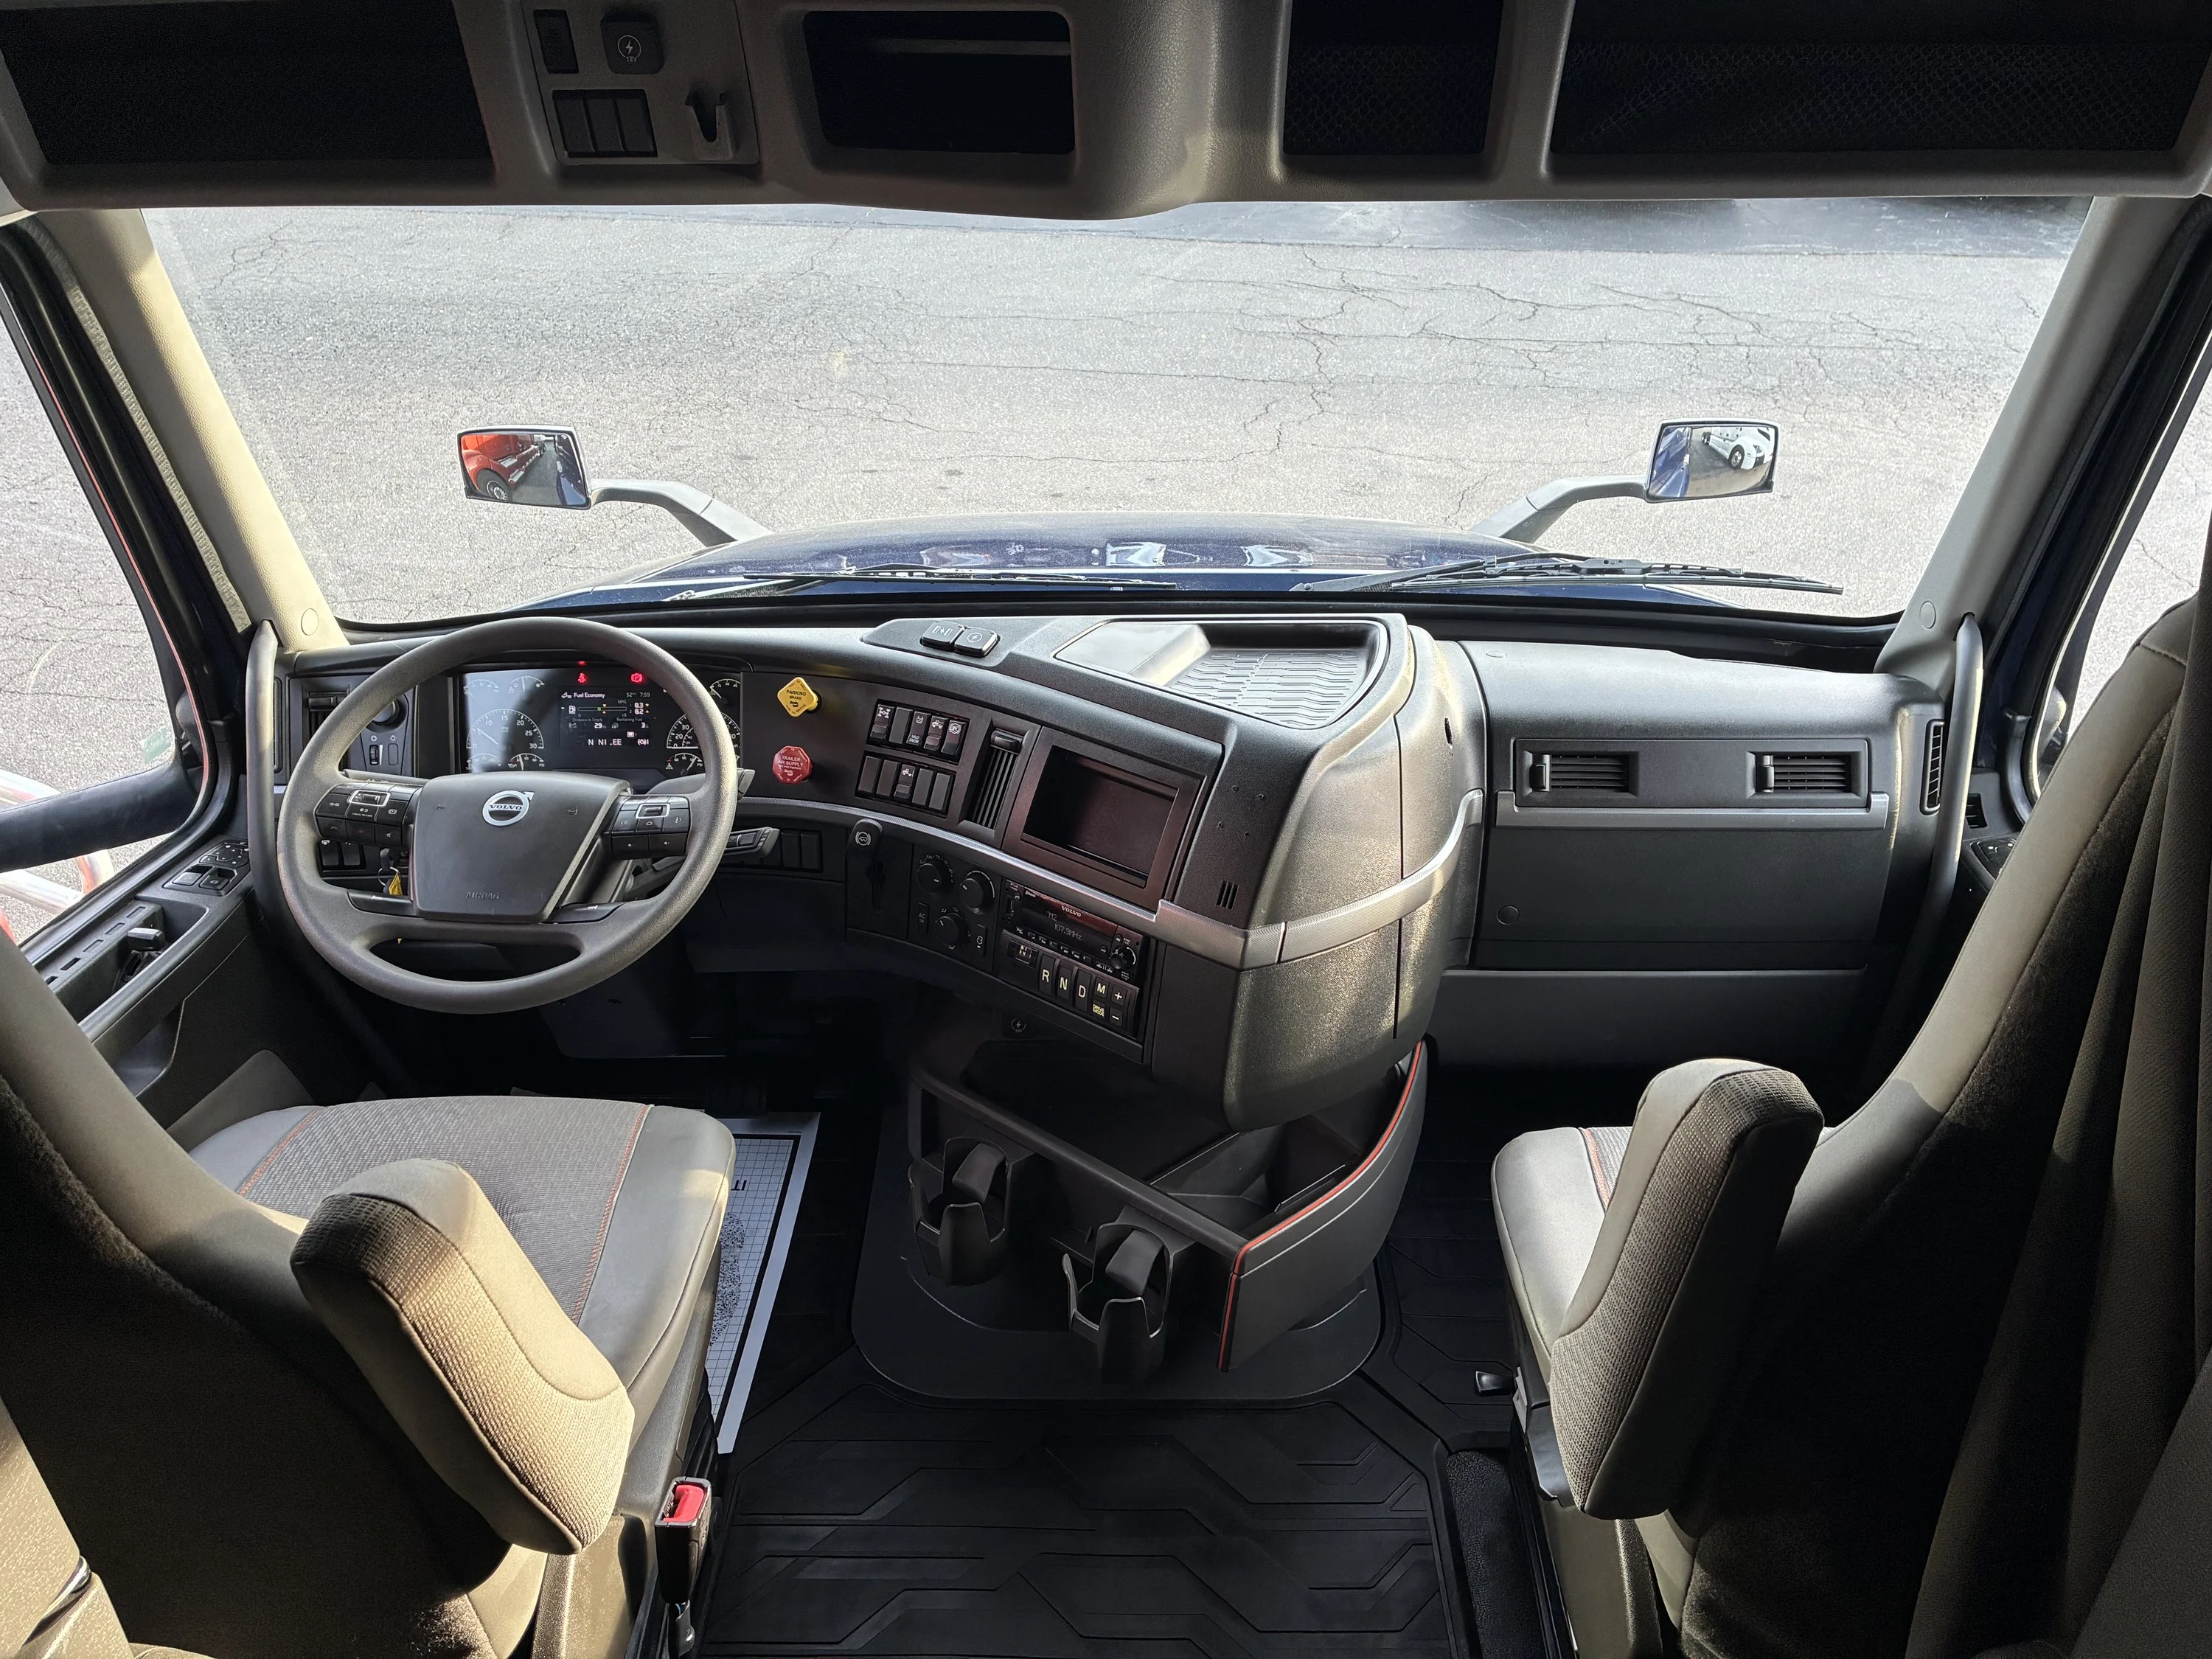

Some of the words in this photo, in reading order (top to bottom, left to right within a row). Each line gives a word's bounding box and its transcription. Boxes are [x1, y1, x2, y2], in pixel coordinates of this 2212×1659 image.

[465, 891, 499, 900] AIRBAG
[1061, 905, 1082, 917] VOLVO
[1042, 969, 1050, 983] R
[1060, 976, 1068, 991] N
[1096, 983, 1105, 994] M
[1078, 984, 1086, 998] D
